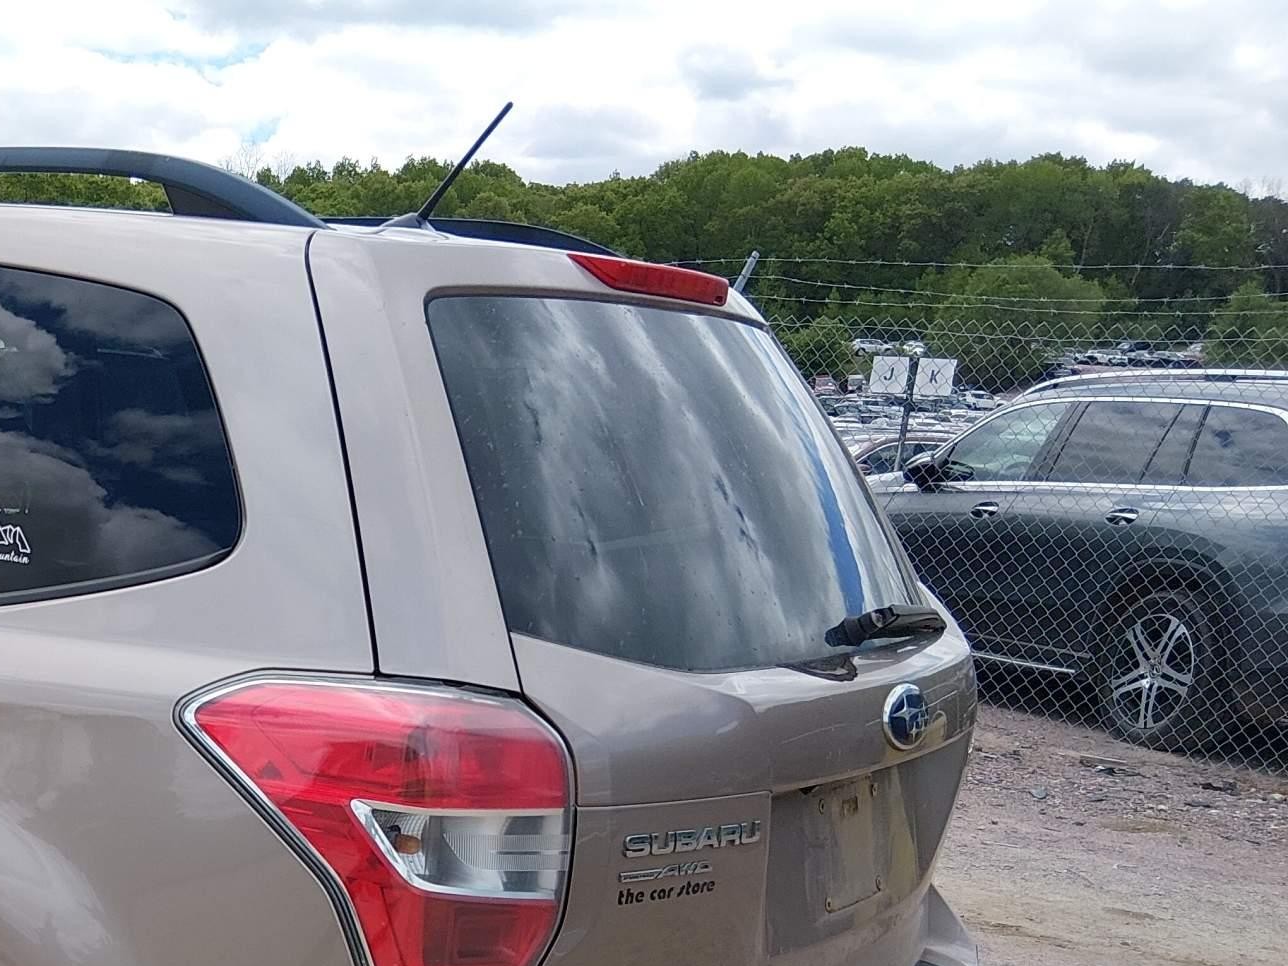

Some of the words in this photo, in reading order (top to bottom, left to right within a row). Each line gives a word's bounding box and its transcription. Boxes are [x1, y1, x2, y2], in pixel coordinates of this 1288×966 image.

[883, 367, 894, 380] J
[929, 369, 941, 384] K
[624, 820, 761, 858] SUBARU
[617, 888, 644, 905] the
[650, 887, 674, 901] car
[676, 880, 715, 898] store
